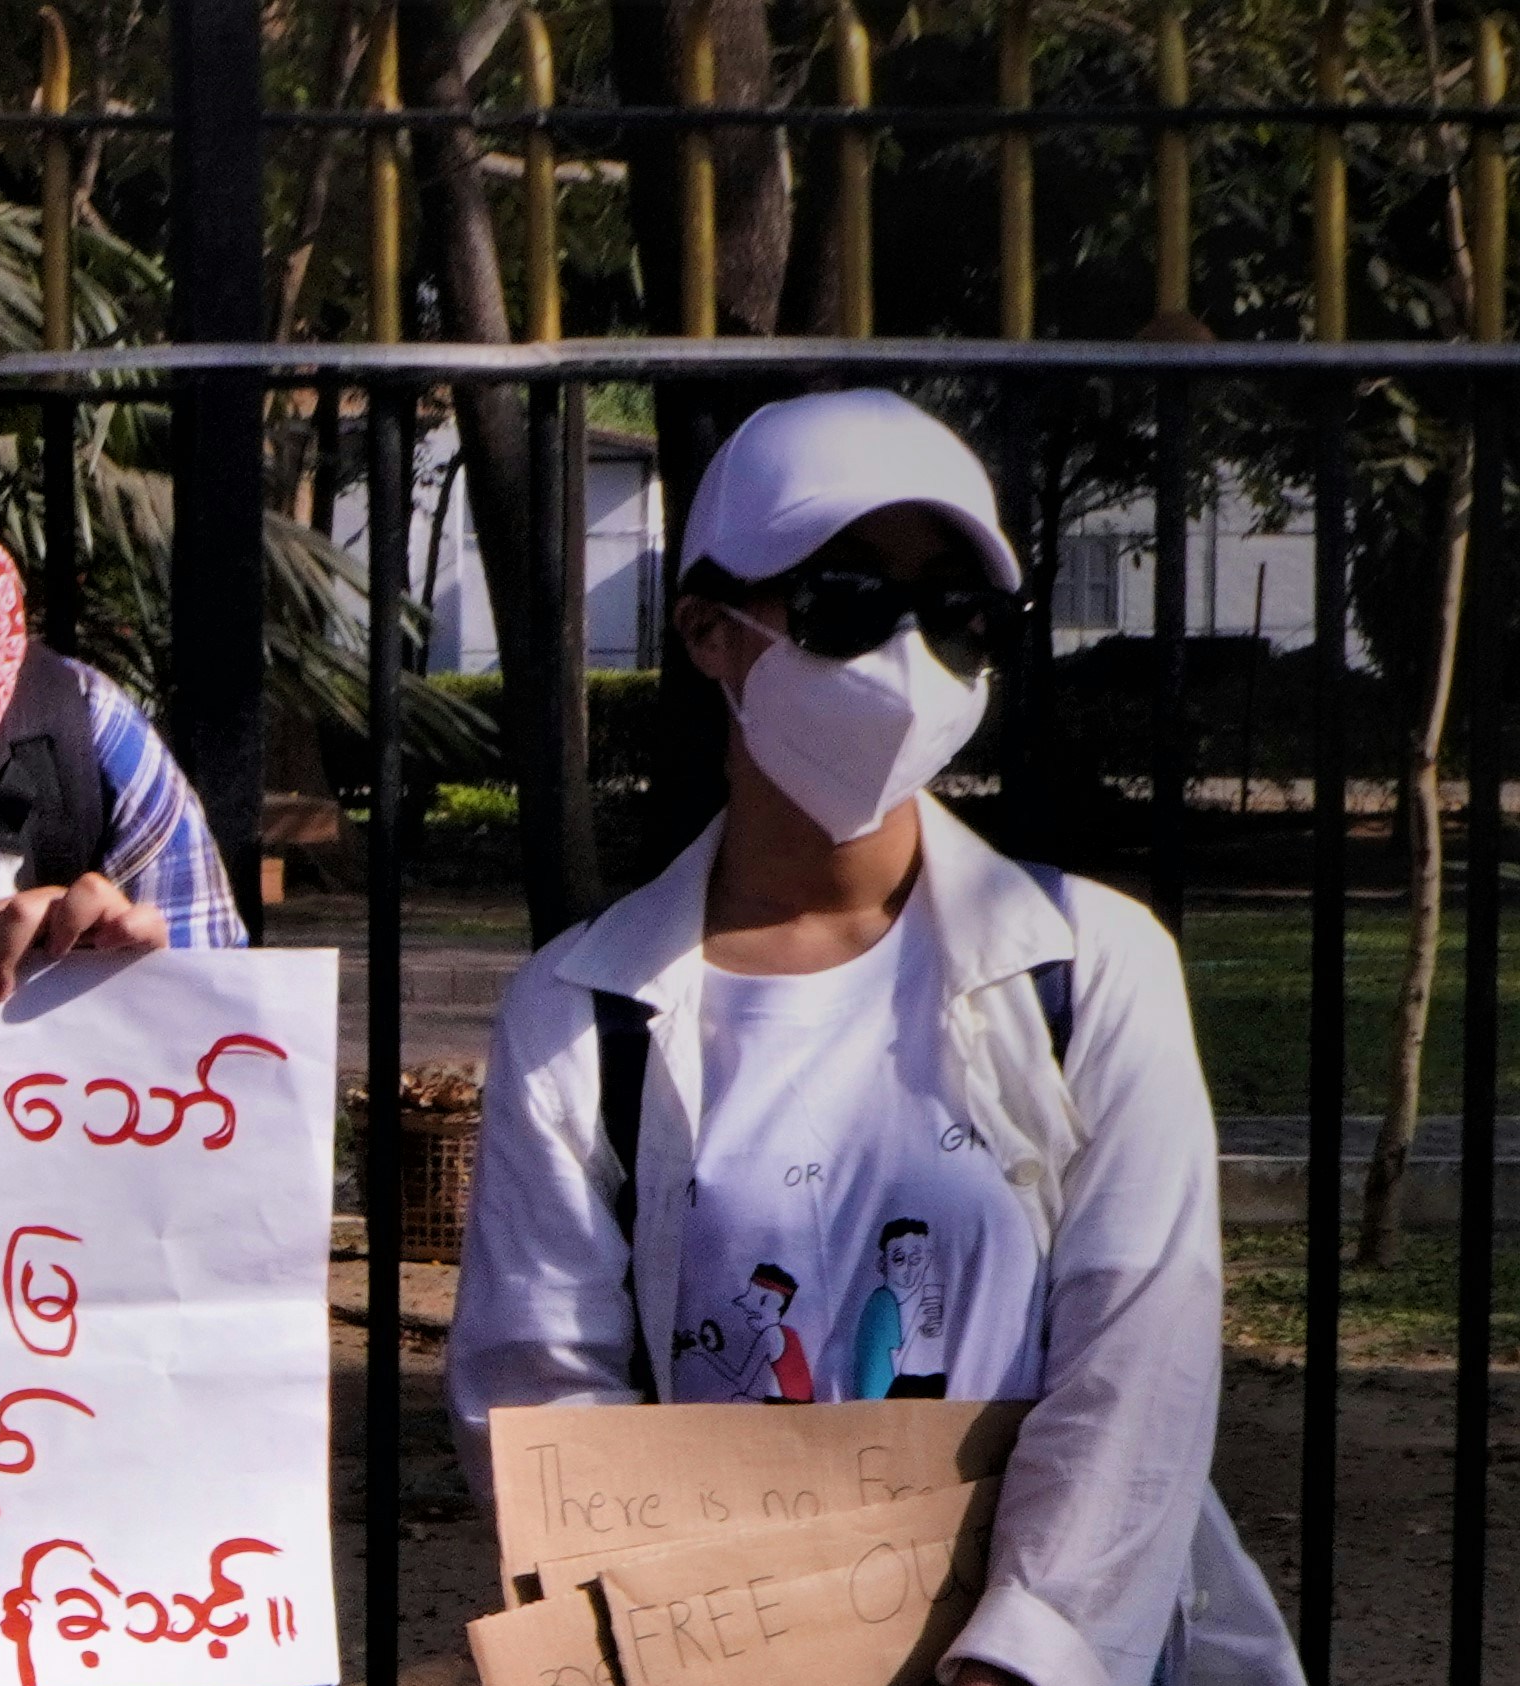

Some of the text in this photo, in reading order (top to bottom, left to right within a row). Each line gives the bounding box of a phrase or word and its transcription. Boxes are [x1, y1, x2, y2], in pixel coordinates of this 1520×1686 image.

[783, 1162, 825, 1188] OR
[525, 1442, 664, 1535] There
[698, 1489, 731, 1522] is
[761, 1488, 822, 1520] no
[625, 1574, 792, 1684] FREE
